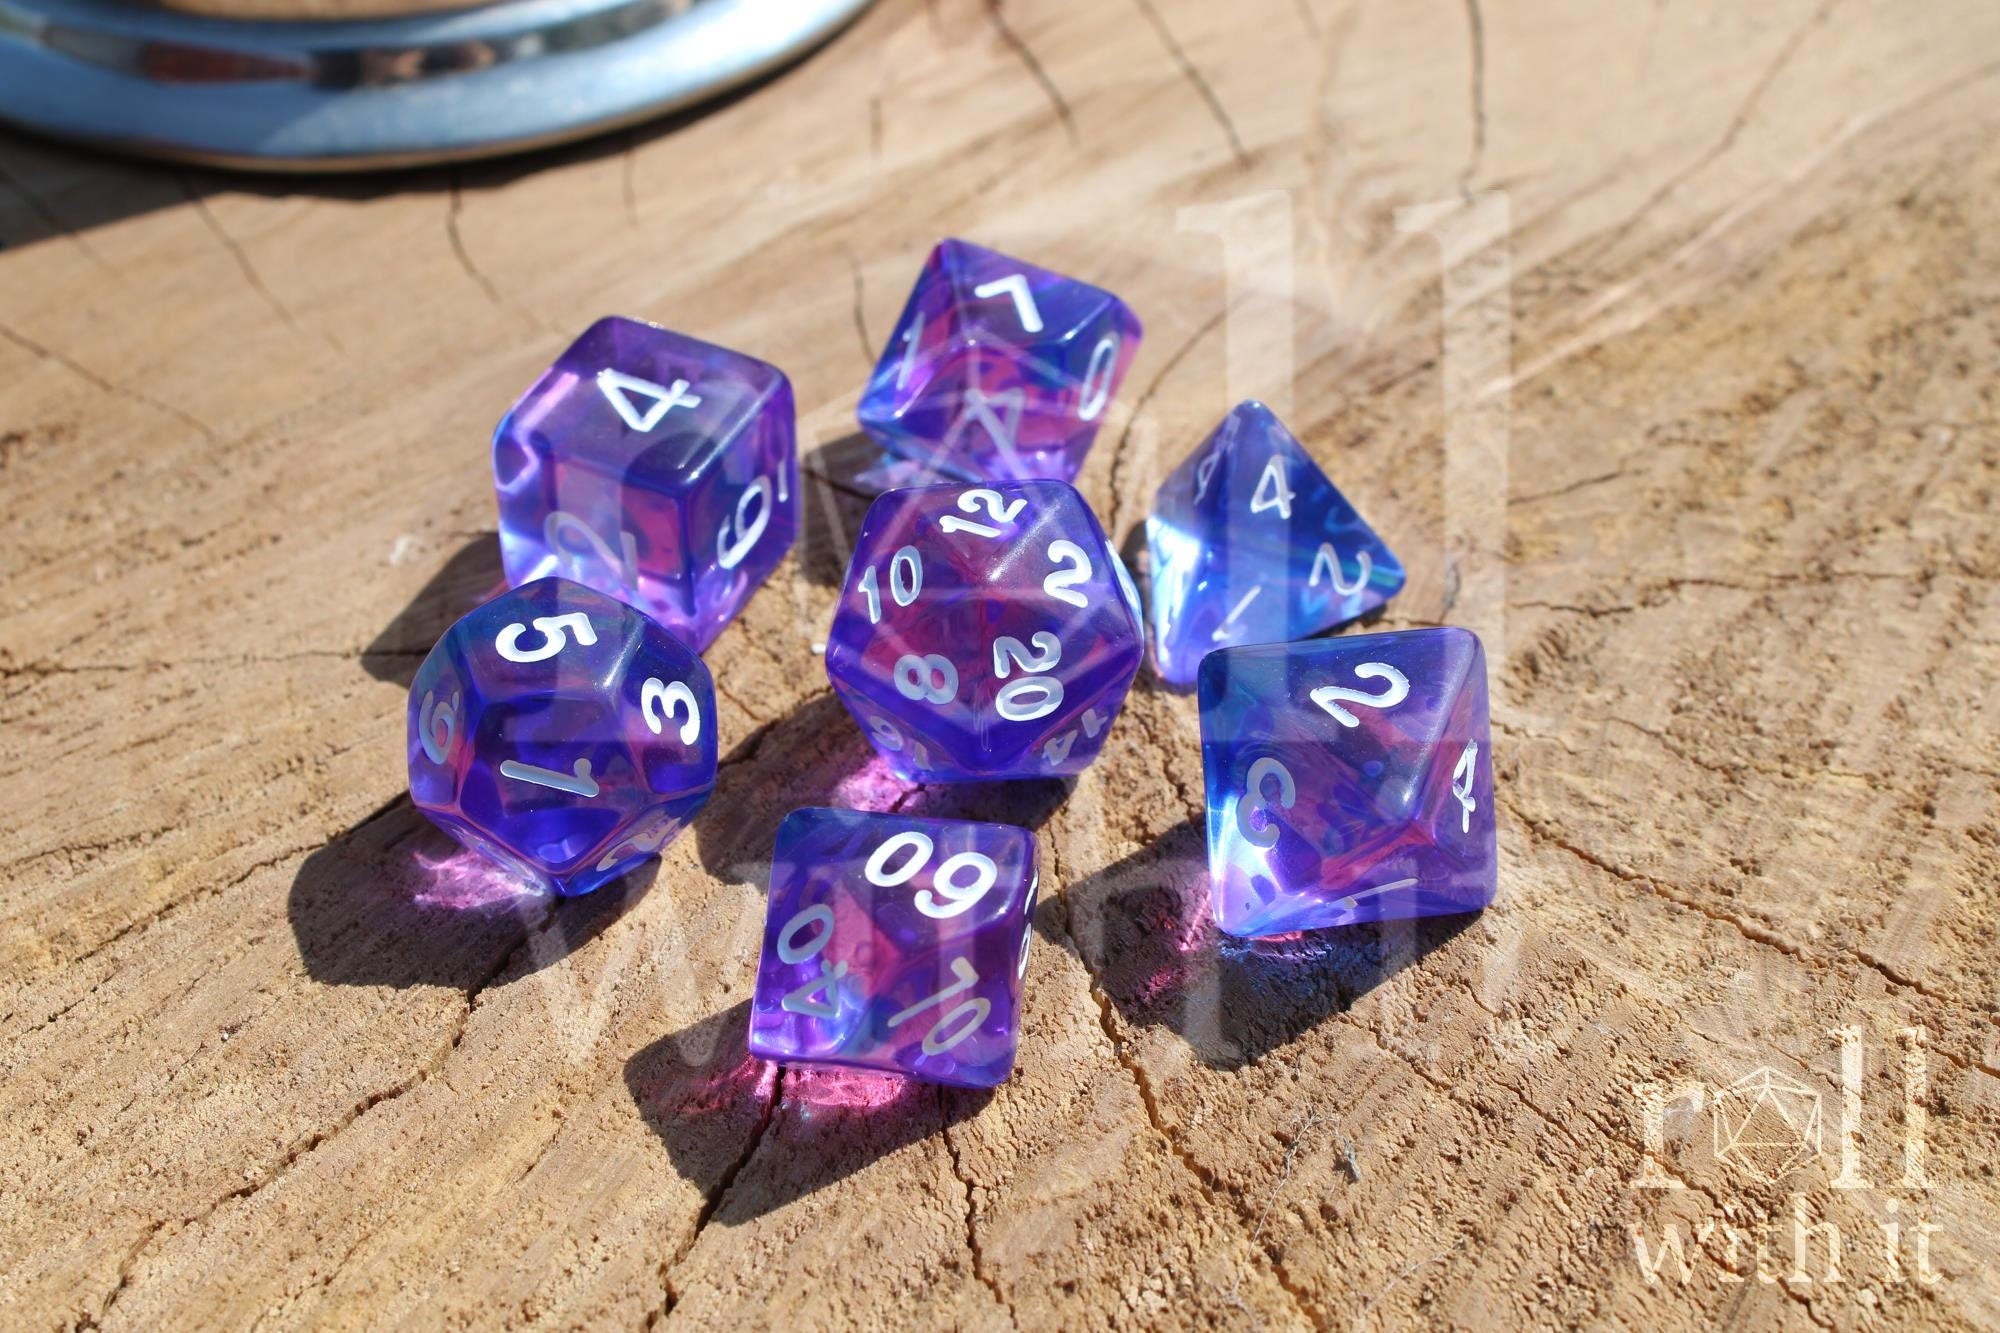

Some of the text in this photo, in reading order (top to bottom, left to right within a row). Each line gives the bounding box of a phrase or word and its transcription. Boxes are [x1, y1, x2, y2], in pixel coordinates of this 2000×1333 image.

[974, 274, 1043, 332] 7
[597, 368, 701, 432] 4
[939, 489, 1028, 538] 12
[1250, 454, 1296, 519] 4
[858, 545, 923, 624] 10
[1044, 540, 1092, 608] 2
[1309, 542, 1372, 596] 2
[495, 612, 598, 663] 5
[894, 654, 959, 704] 8
[993, 631, 1064, 721] 20
[1310, 662, 1411, 728] 2
[641, 677, 701, 746] 3
[500, 758, 599, 798] 1
[1236, 757, 1296, 849] 3
[1452, 738, 1479, 833] 4
[777, 903, 849, 1020] 40
[887, 955, 991, 1057] 10
